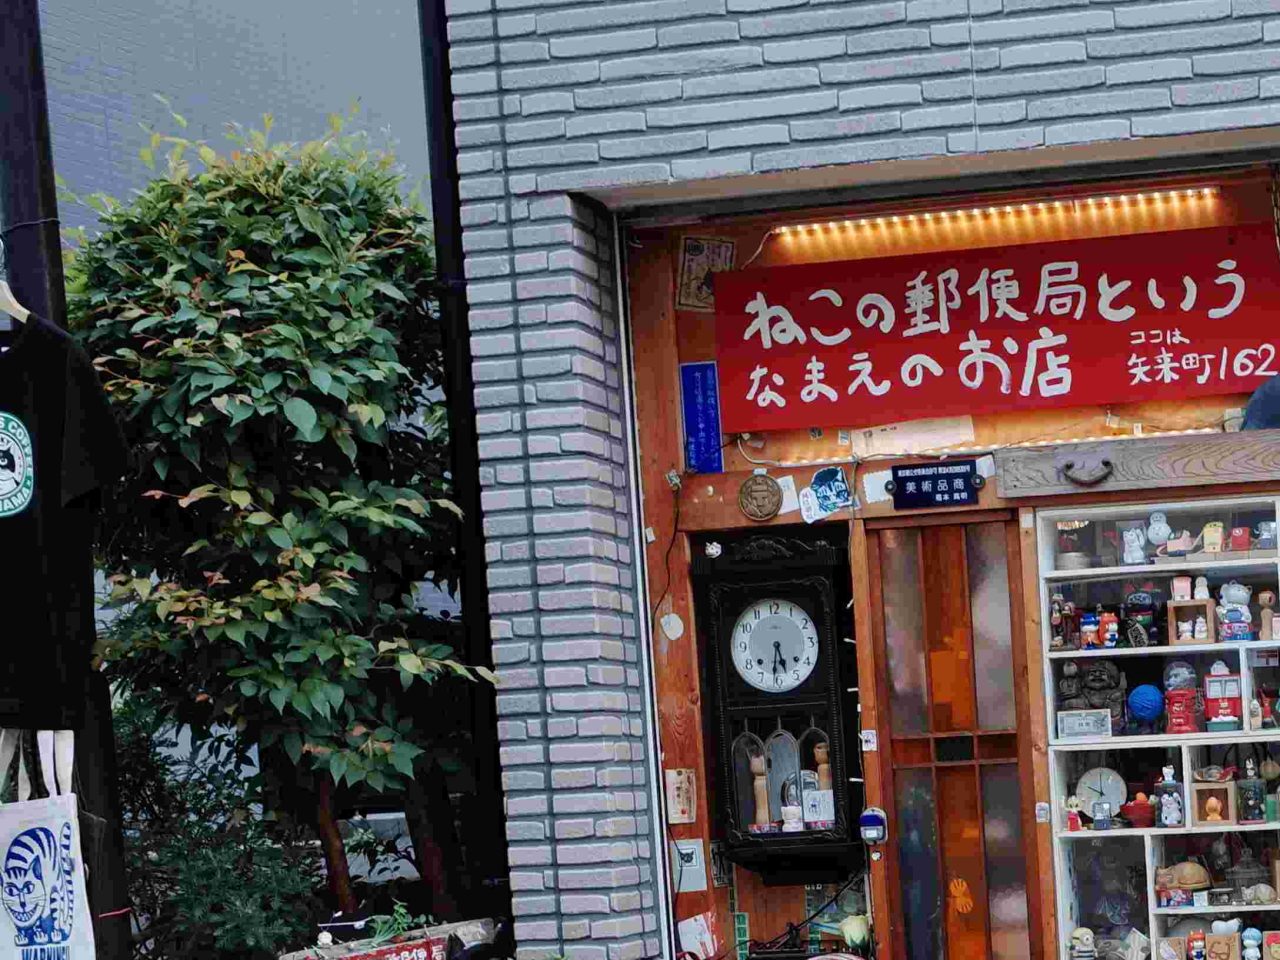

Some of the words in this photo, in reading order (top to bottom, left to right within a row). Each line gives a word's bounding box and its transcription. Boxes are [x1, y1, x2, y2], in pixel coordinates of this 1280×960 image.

[743, 259, 1246, 349] ねこの郵便局という
[1130, 328, 1190, 345] ココは
[746, 326, 1072, 408] なまえのお店
[1127, 343, 1279, 386] 矢来町162
[906, 478, 965, 493] 美術品商
[753, 609, 761, 620] 11
[769, 601, 780, 615] 12
[789, 606, 794, 617] 1
[740, 622, 752, 634] 10
[801, 618, 809, 630] 2
[739, 641, 747, 652] 9
[808, 636, 815, 649] 3
[745, 658, 753, 670] 8
[802, 656, 812, 666] 4
[756, 671, 765, 684] 7
[775, 675, 784, 688] 6
[792, 669, 800, 681] 5
